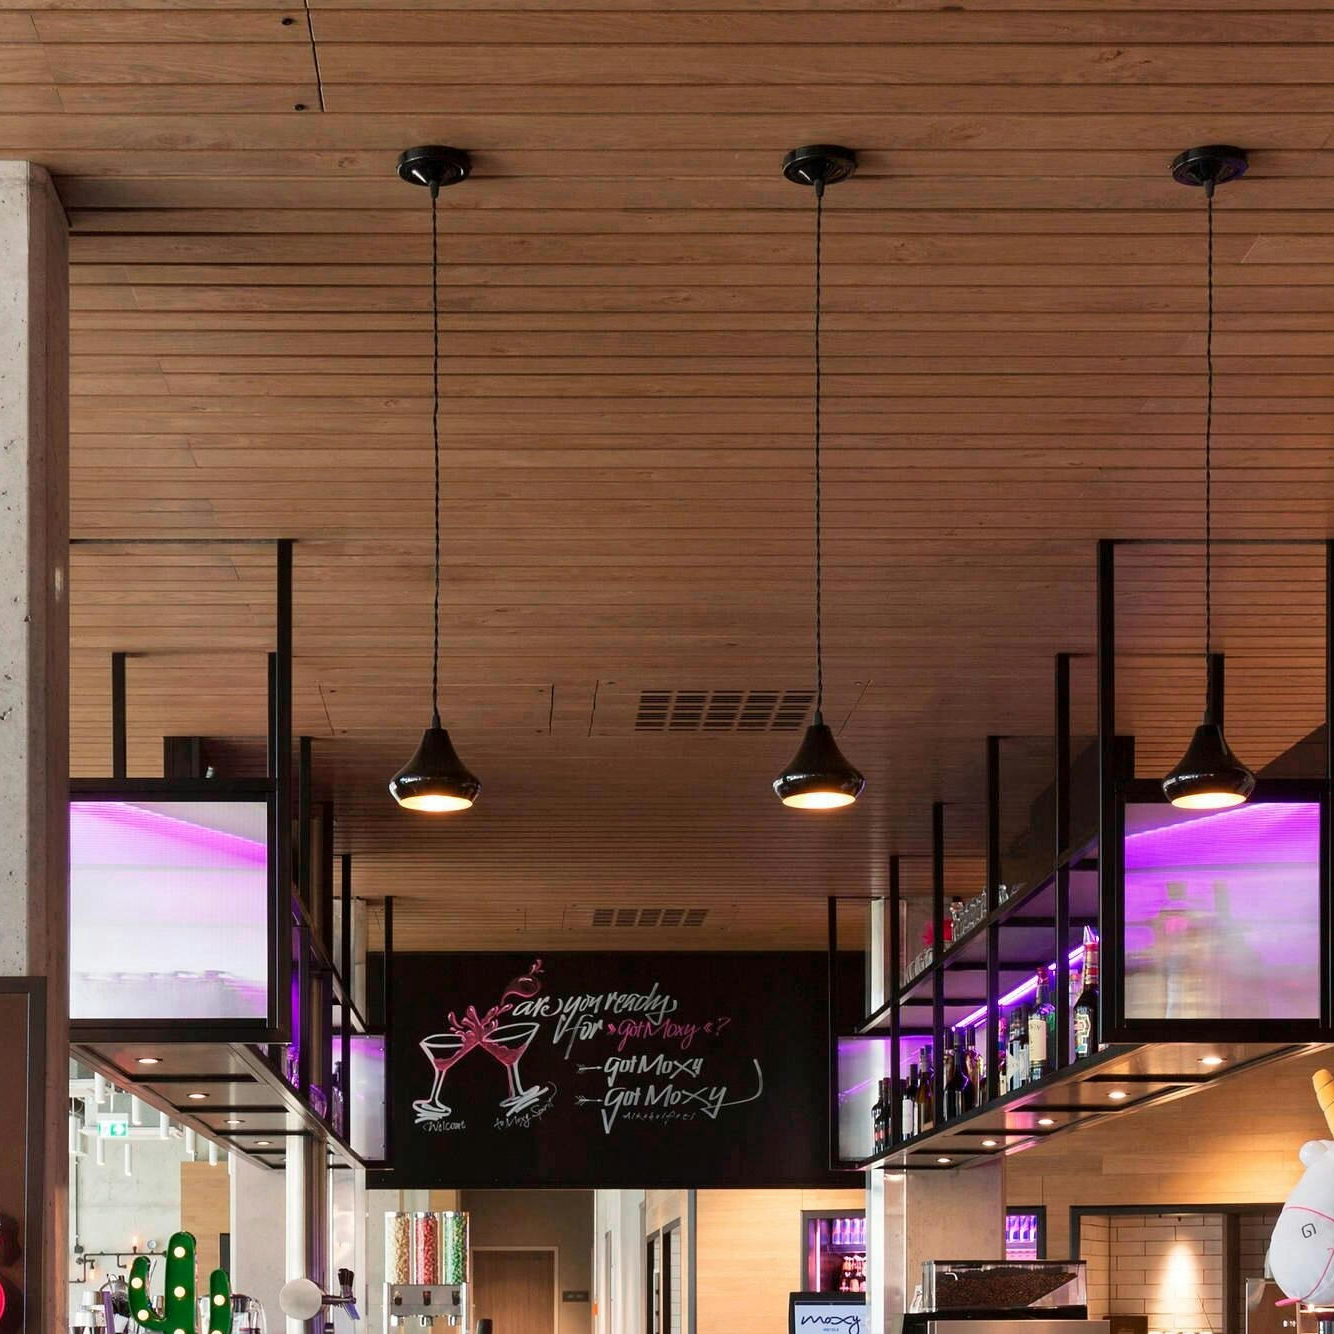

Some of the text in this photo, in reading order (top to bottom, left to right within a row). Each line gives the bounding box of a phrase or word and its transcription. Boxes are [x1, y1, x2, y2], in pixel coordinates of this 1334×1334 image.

[512, 996, 563, 1017] are
[604, 982, 678, 1026] ready
[563, 1014, 604, 1060] for
